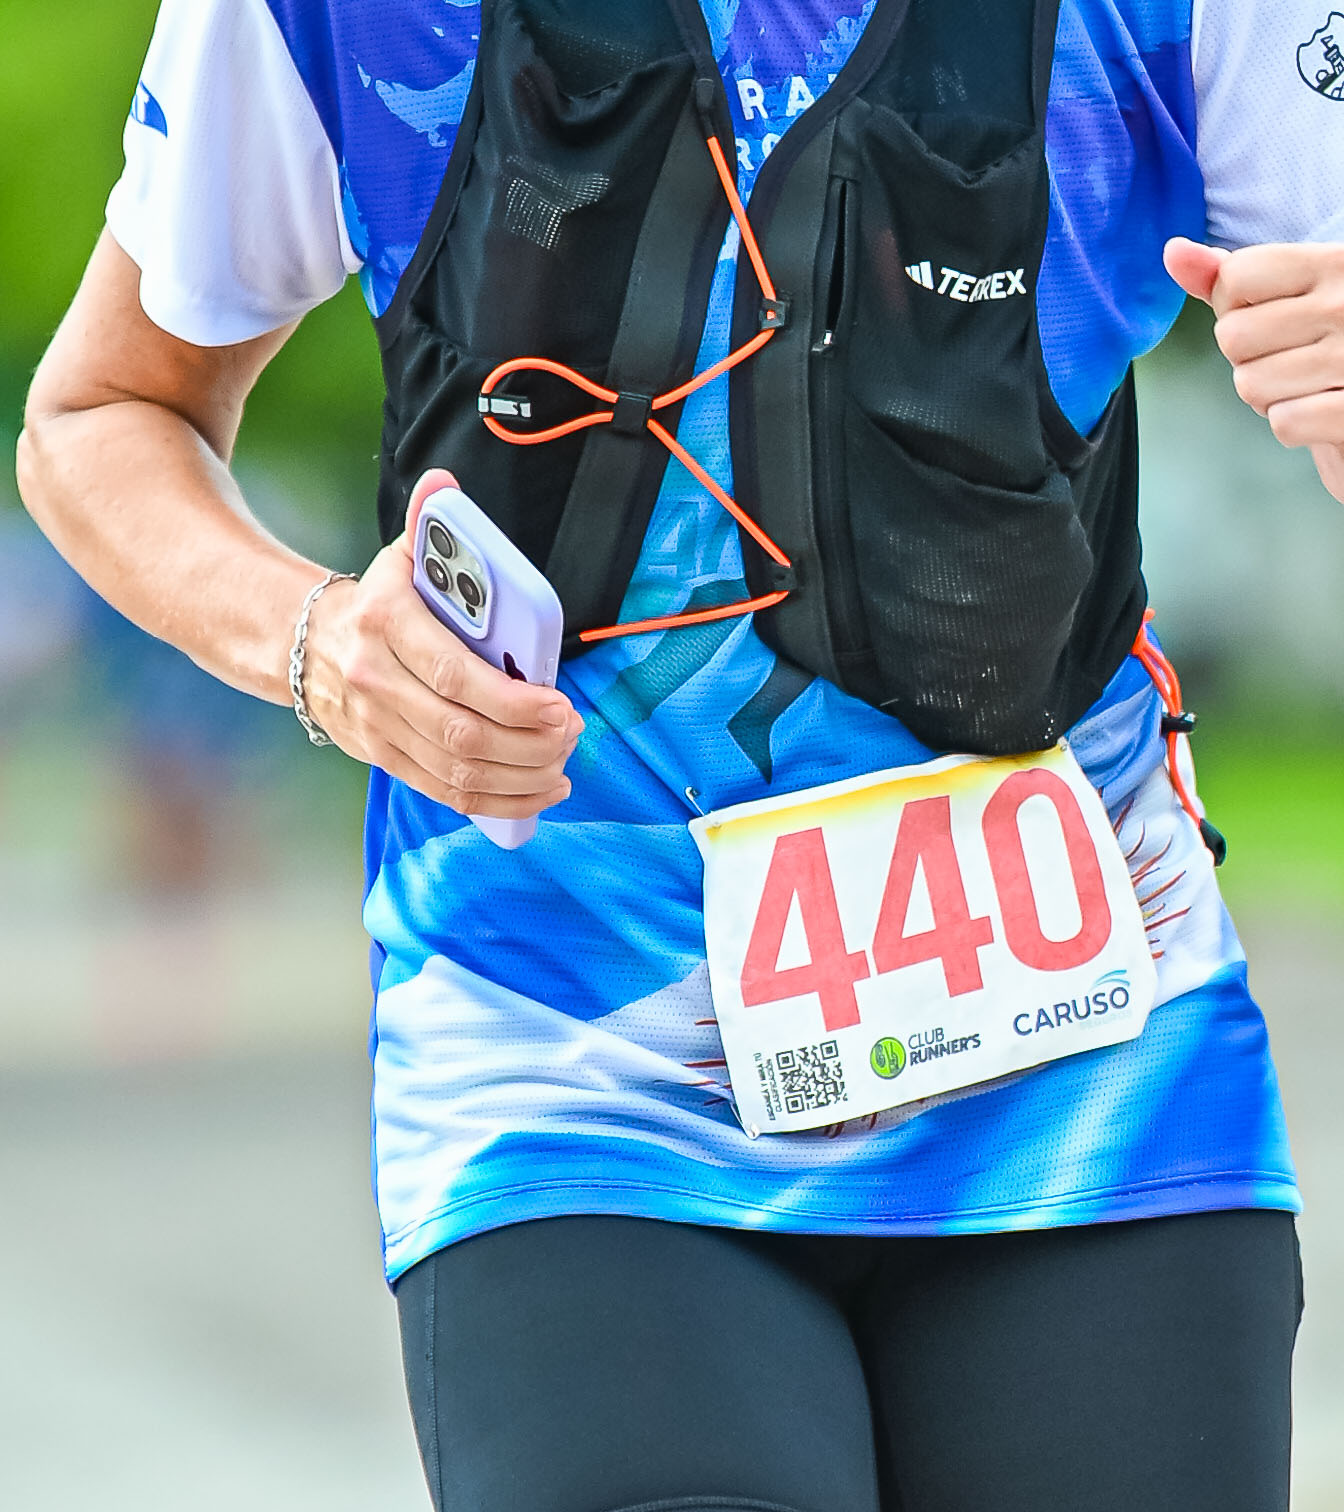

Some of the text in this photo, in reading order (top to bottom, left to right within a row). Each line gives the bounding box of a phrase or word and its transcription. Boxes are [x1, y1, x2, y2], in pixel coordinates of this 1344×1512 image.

[740, 768, 1112, 1032] 440
[1013, 986, 1130, 1036] CARUSO
[908, 1027, 945, 1050] CLUB
[909, 1033, 982, 1067] RUNNER'S
